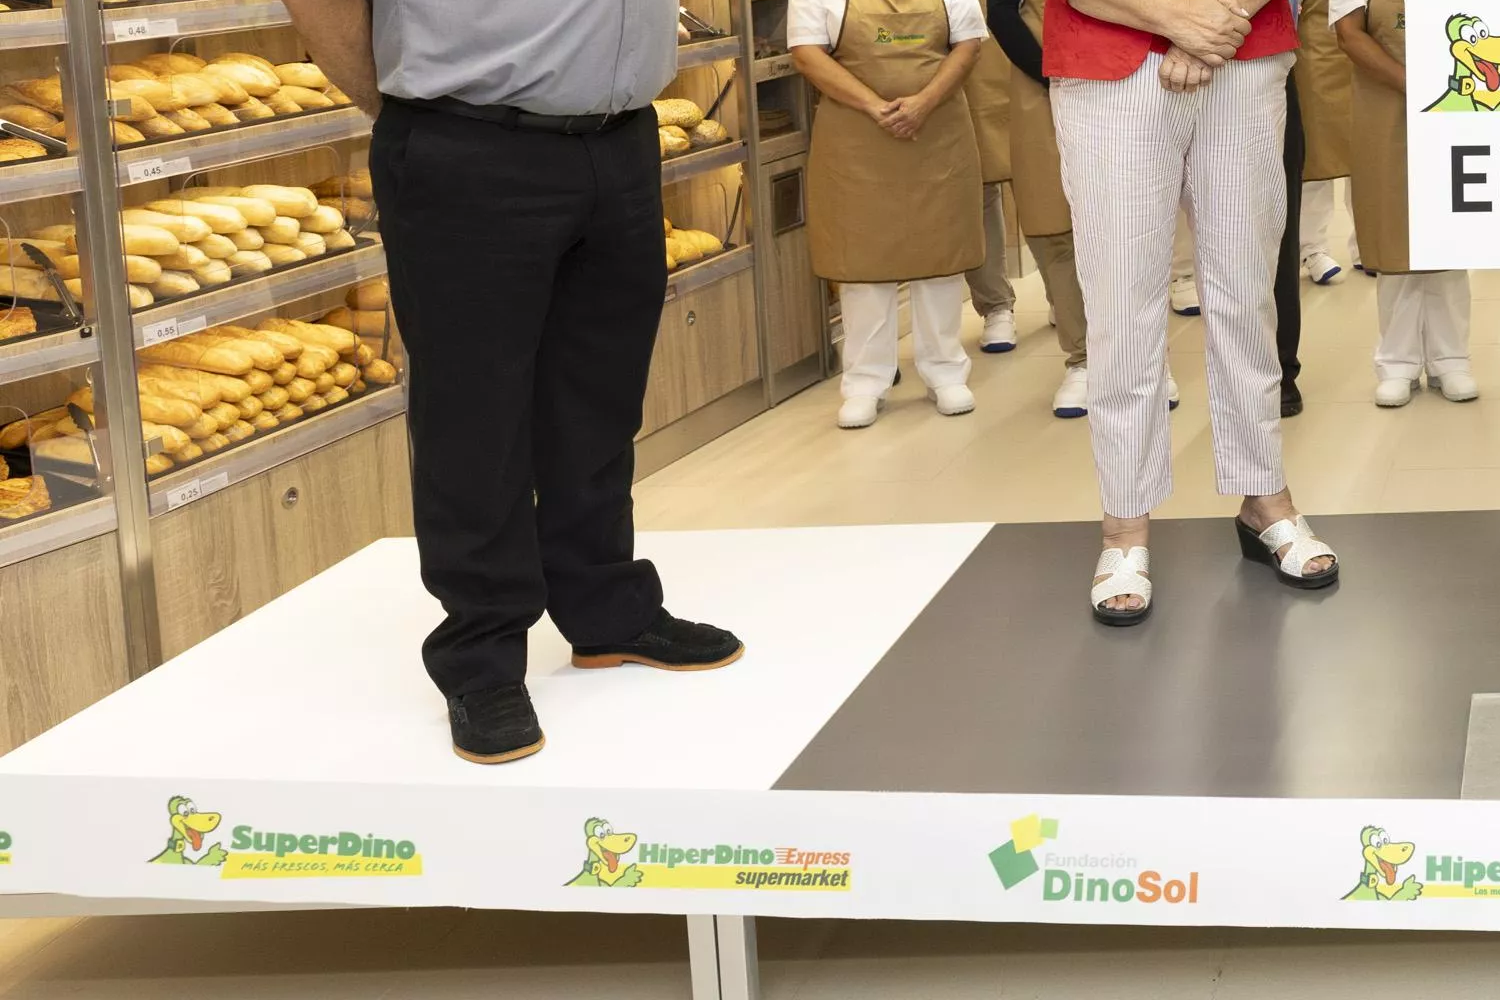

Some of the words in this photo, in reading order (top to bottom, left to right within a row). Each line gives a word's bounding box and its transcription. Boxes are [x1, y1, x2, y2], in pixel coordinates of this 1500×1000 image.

[231, 825, 415, 860] SuperDino
[241, 860, 268, 871] MÁS
[272, 861, 330, 873] FRESCOS,
[333, 860, 360, 871] MÁS
[364, 860, 404, 872] CERCA
[639, 843, 775, 868] HiperDino
[784, 848, 850, 871] Express
[1044, 852, 1137, 868] Fundación
[736, 869, 848, 889] supermarket
[1043, 869, 1198, 903] DinoSol
